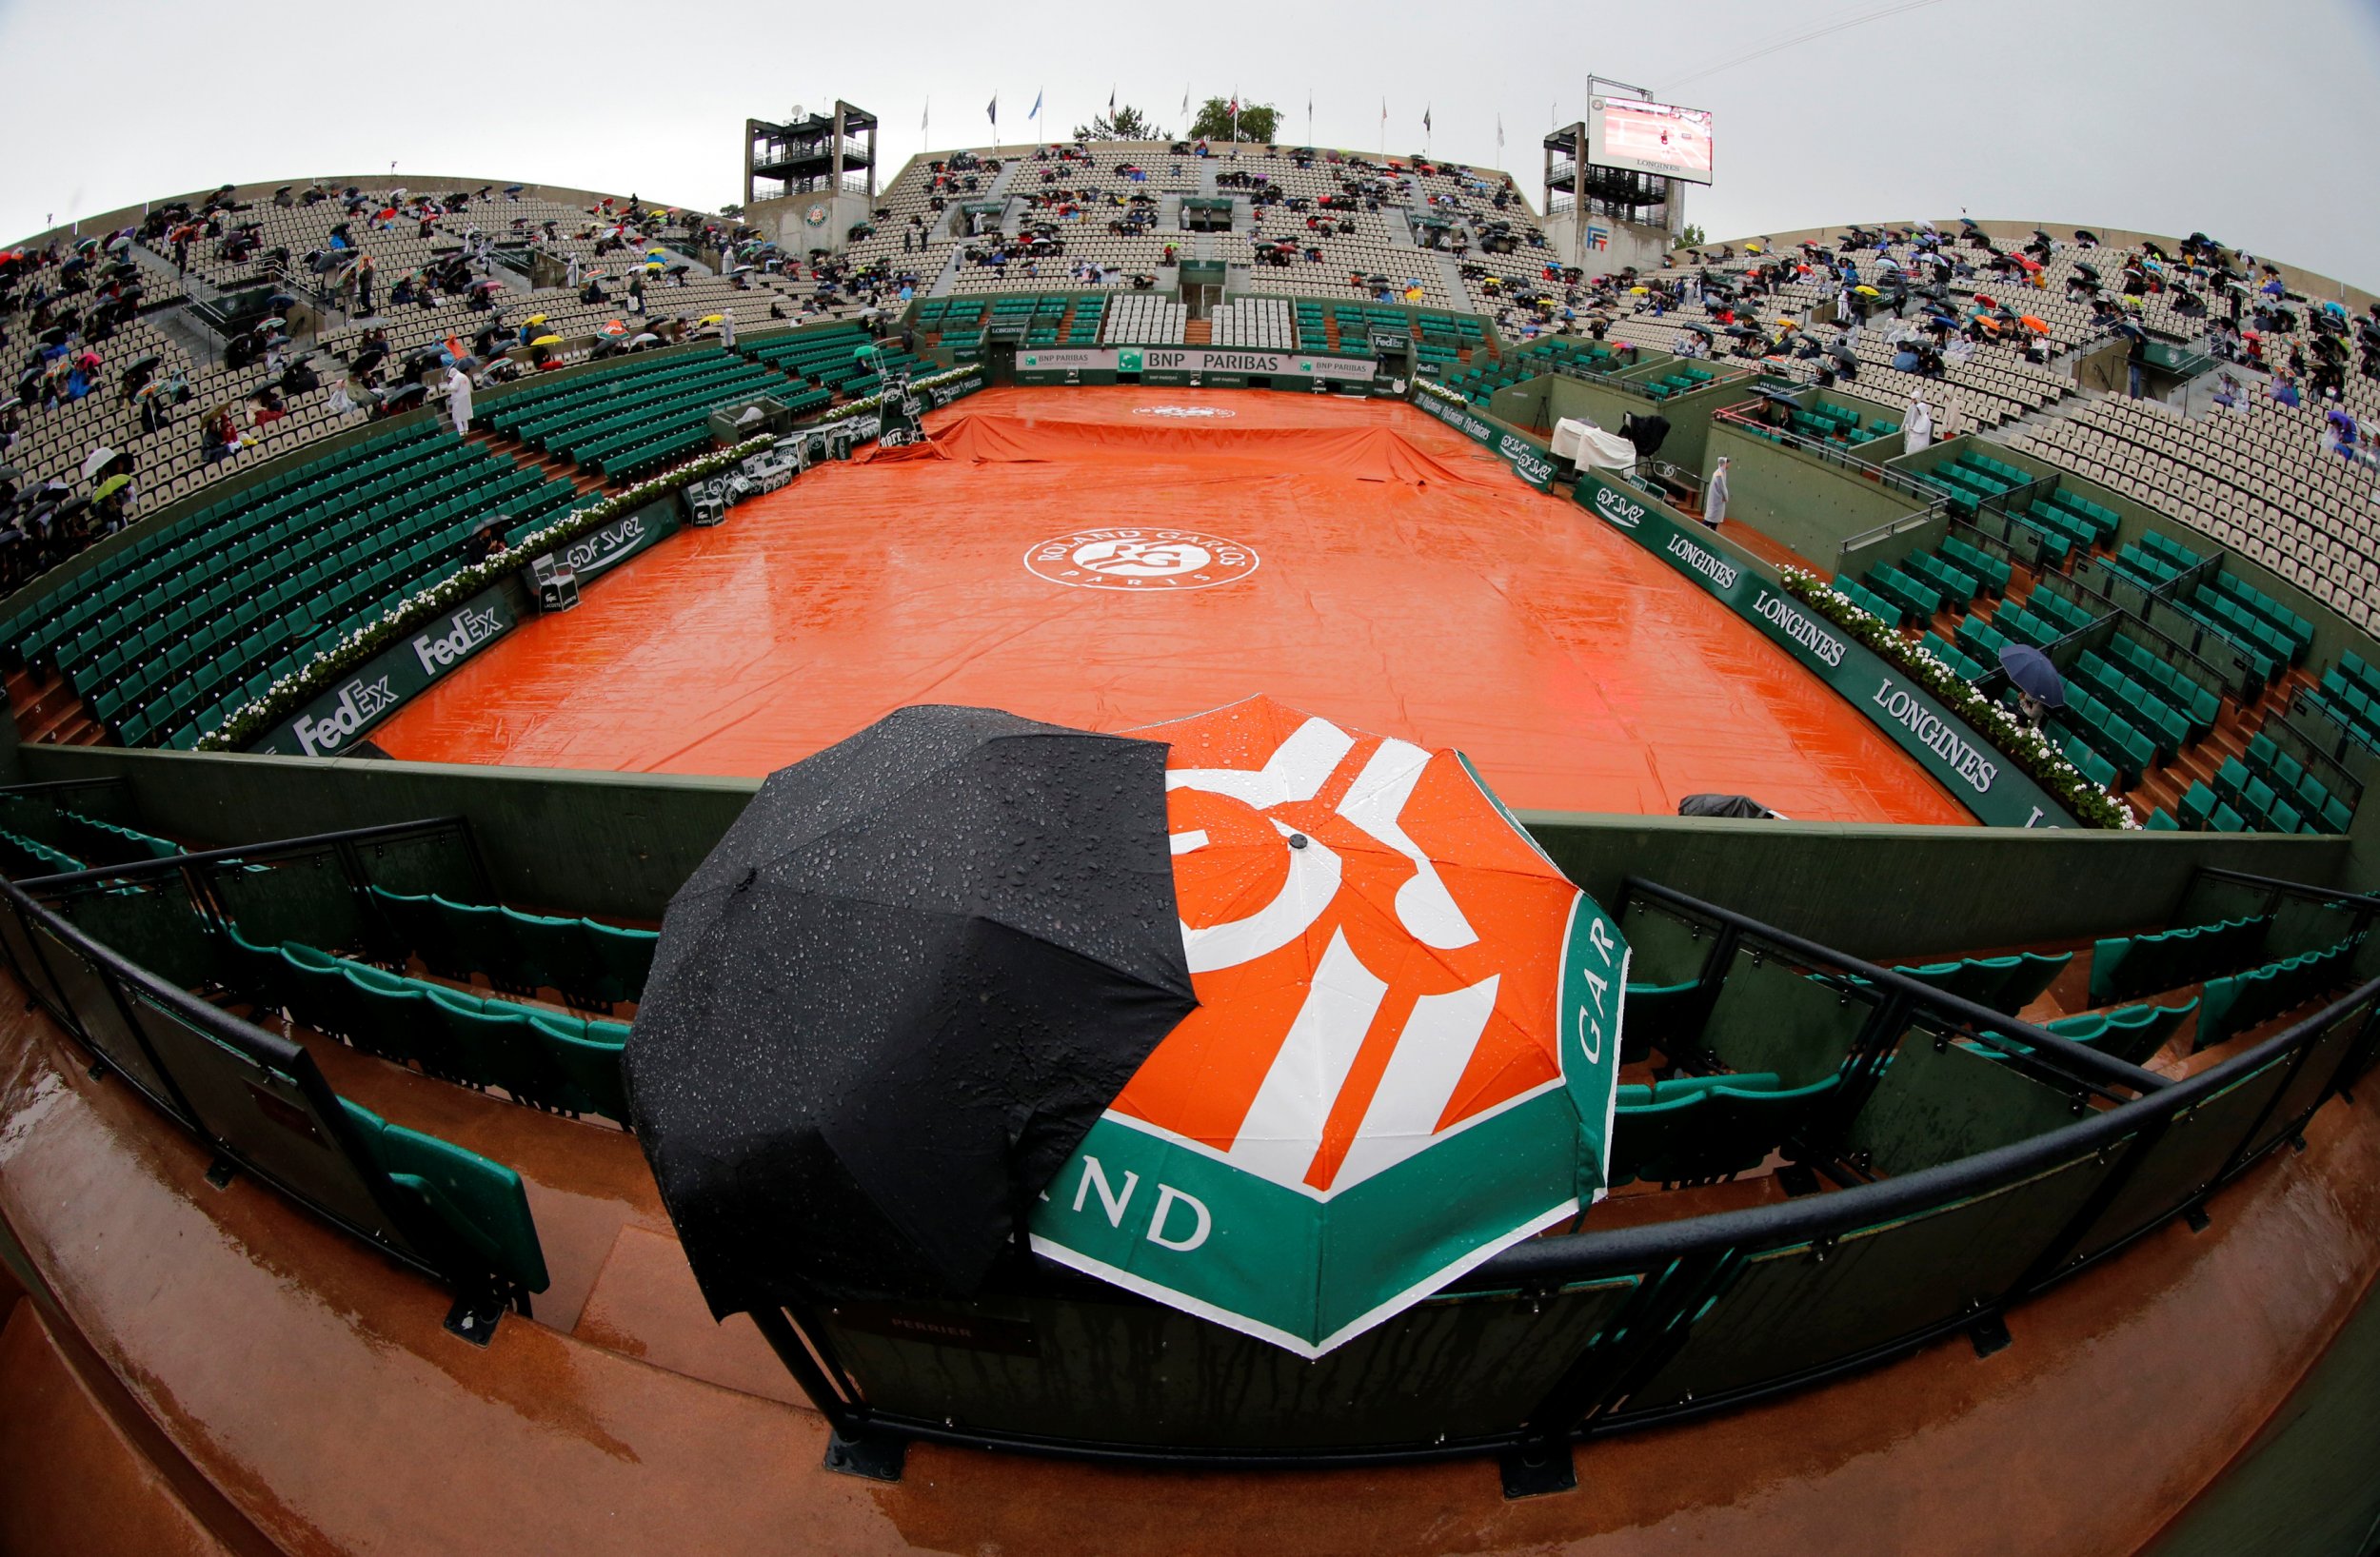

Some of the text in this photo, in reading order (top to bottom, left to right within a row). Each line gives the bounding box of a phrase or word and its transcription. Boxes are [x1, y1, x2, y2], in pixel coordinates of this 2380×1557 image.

[1636, 159, 1680, 172] LONGINES
[1587, 226, 1608, 252] FFT
[1375, 337, 1403, 348] FedEx
[1149, 352, 1279, 371] BNP PARIBAS
[1316, 362, 1366, 372] BNP PARIBAS
[1517, 453, 1535, 467] GDF
[1597, 487, 1616, 506] GDF
[566, 538, 598, 568] GDF
[1037, 530, 1246, 567] ROLAND GARROS
[1666, 533, 1738, 590] LONGINES
[1060, 570, 1211, 586] PARIS
[411, 606, 504, 677] FedEx
[1753, 590, 1847, 668] LONGINES
[291, 675, 399, 758] FedEx
[1872, 678, 1999, 794] LONGINES
[1578, 916, 1614, 1065] GAR
[1071, 1154, 1212, 1252] ND
[891, 1317, 972, 1337] PERRIER
